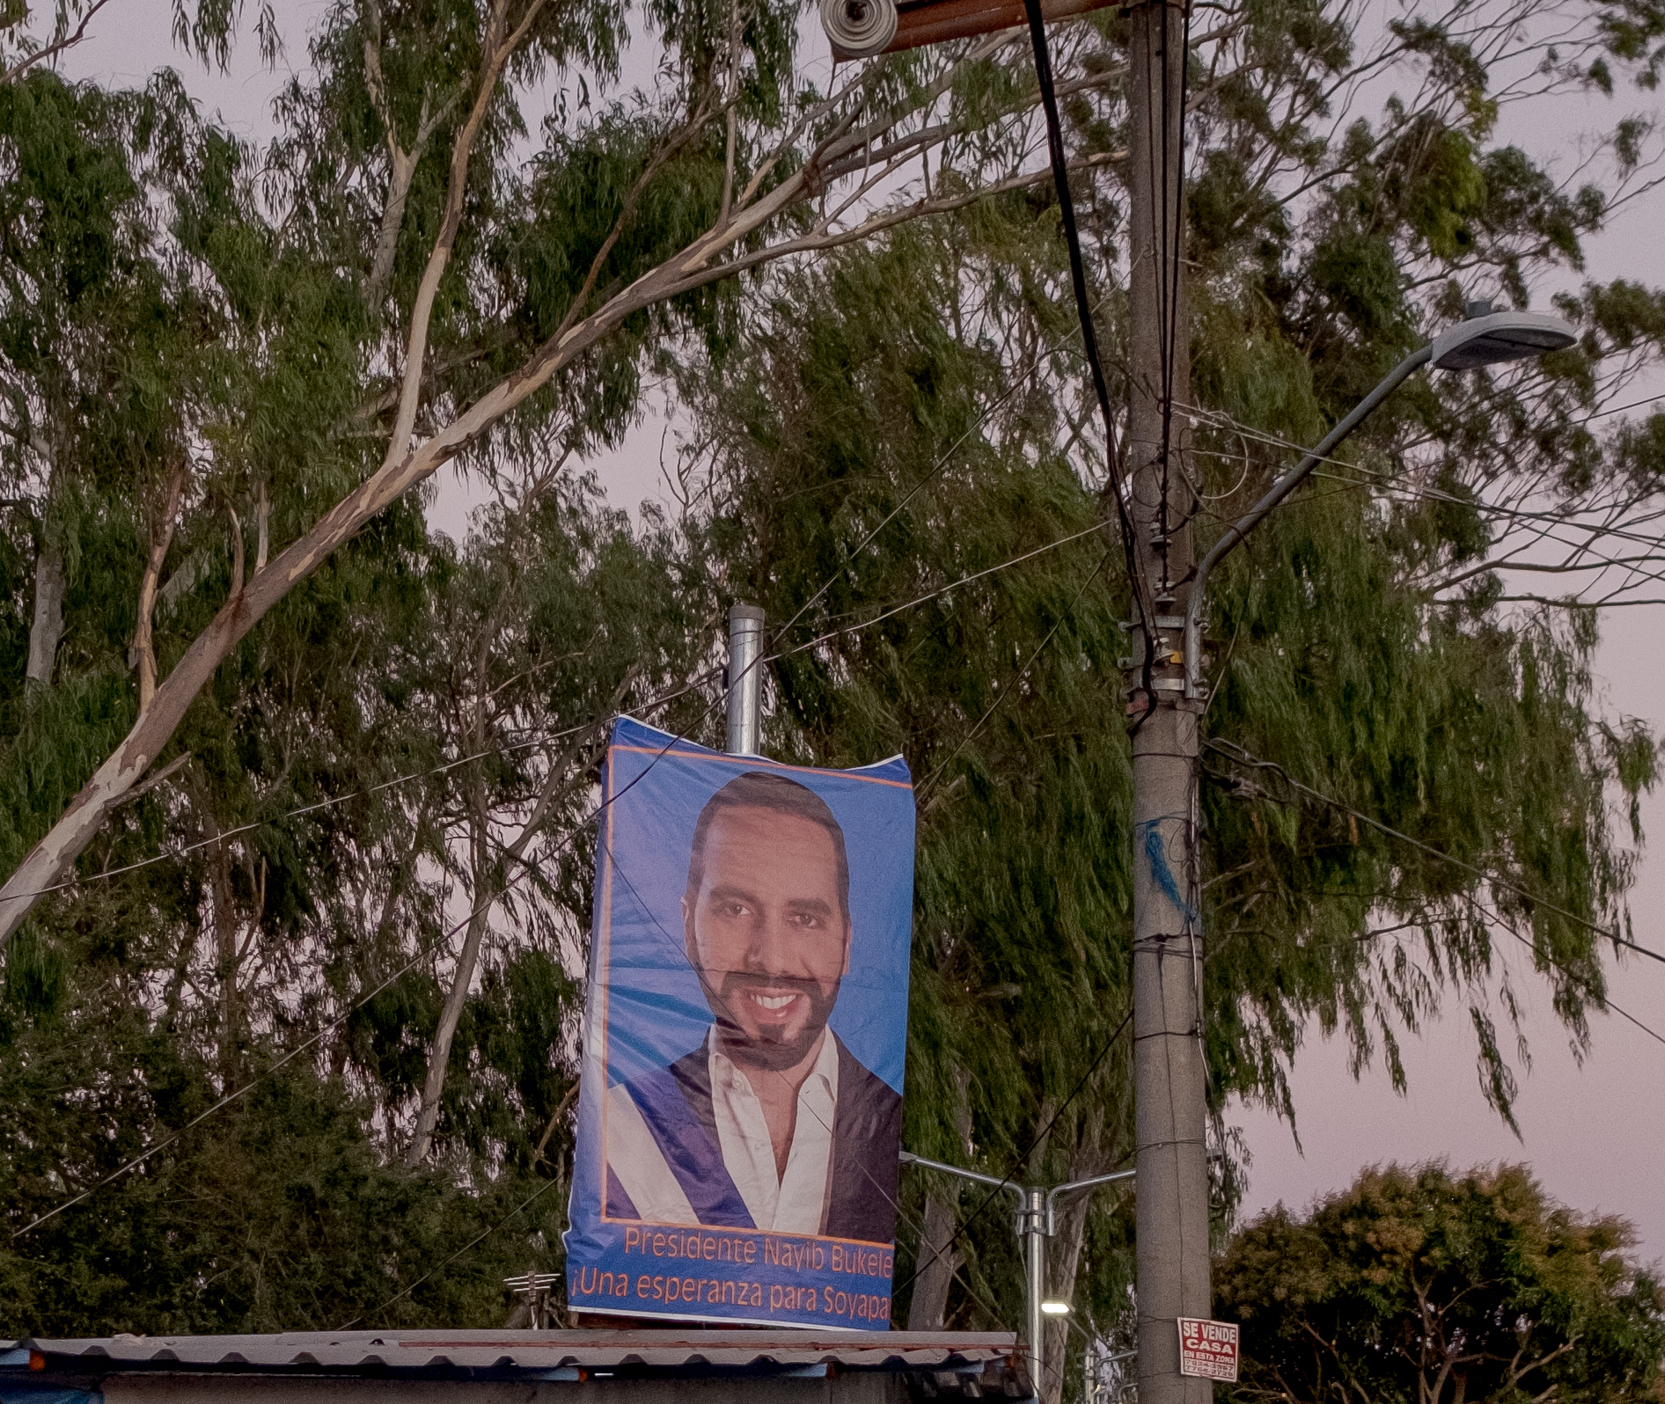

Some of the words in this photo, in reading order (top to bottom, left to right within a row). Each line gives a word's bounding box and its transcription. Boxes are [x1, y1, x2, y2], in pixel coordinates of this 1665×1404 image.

[624, 1226, 756, 1264] Presidente
[764, 1237, 824, 1272] Nayib
[830, 1246, 892, 1280] Bukele
[636, 1272, 762, 1306] esperanza
[769, 1283, 817, 1315] para
[1183, 1322, 1199, 1338] SE
[1201, 1323, 1236, 1343] VENDE
[1186, 1338, 1233, 1355] CASA
